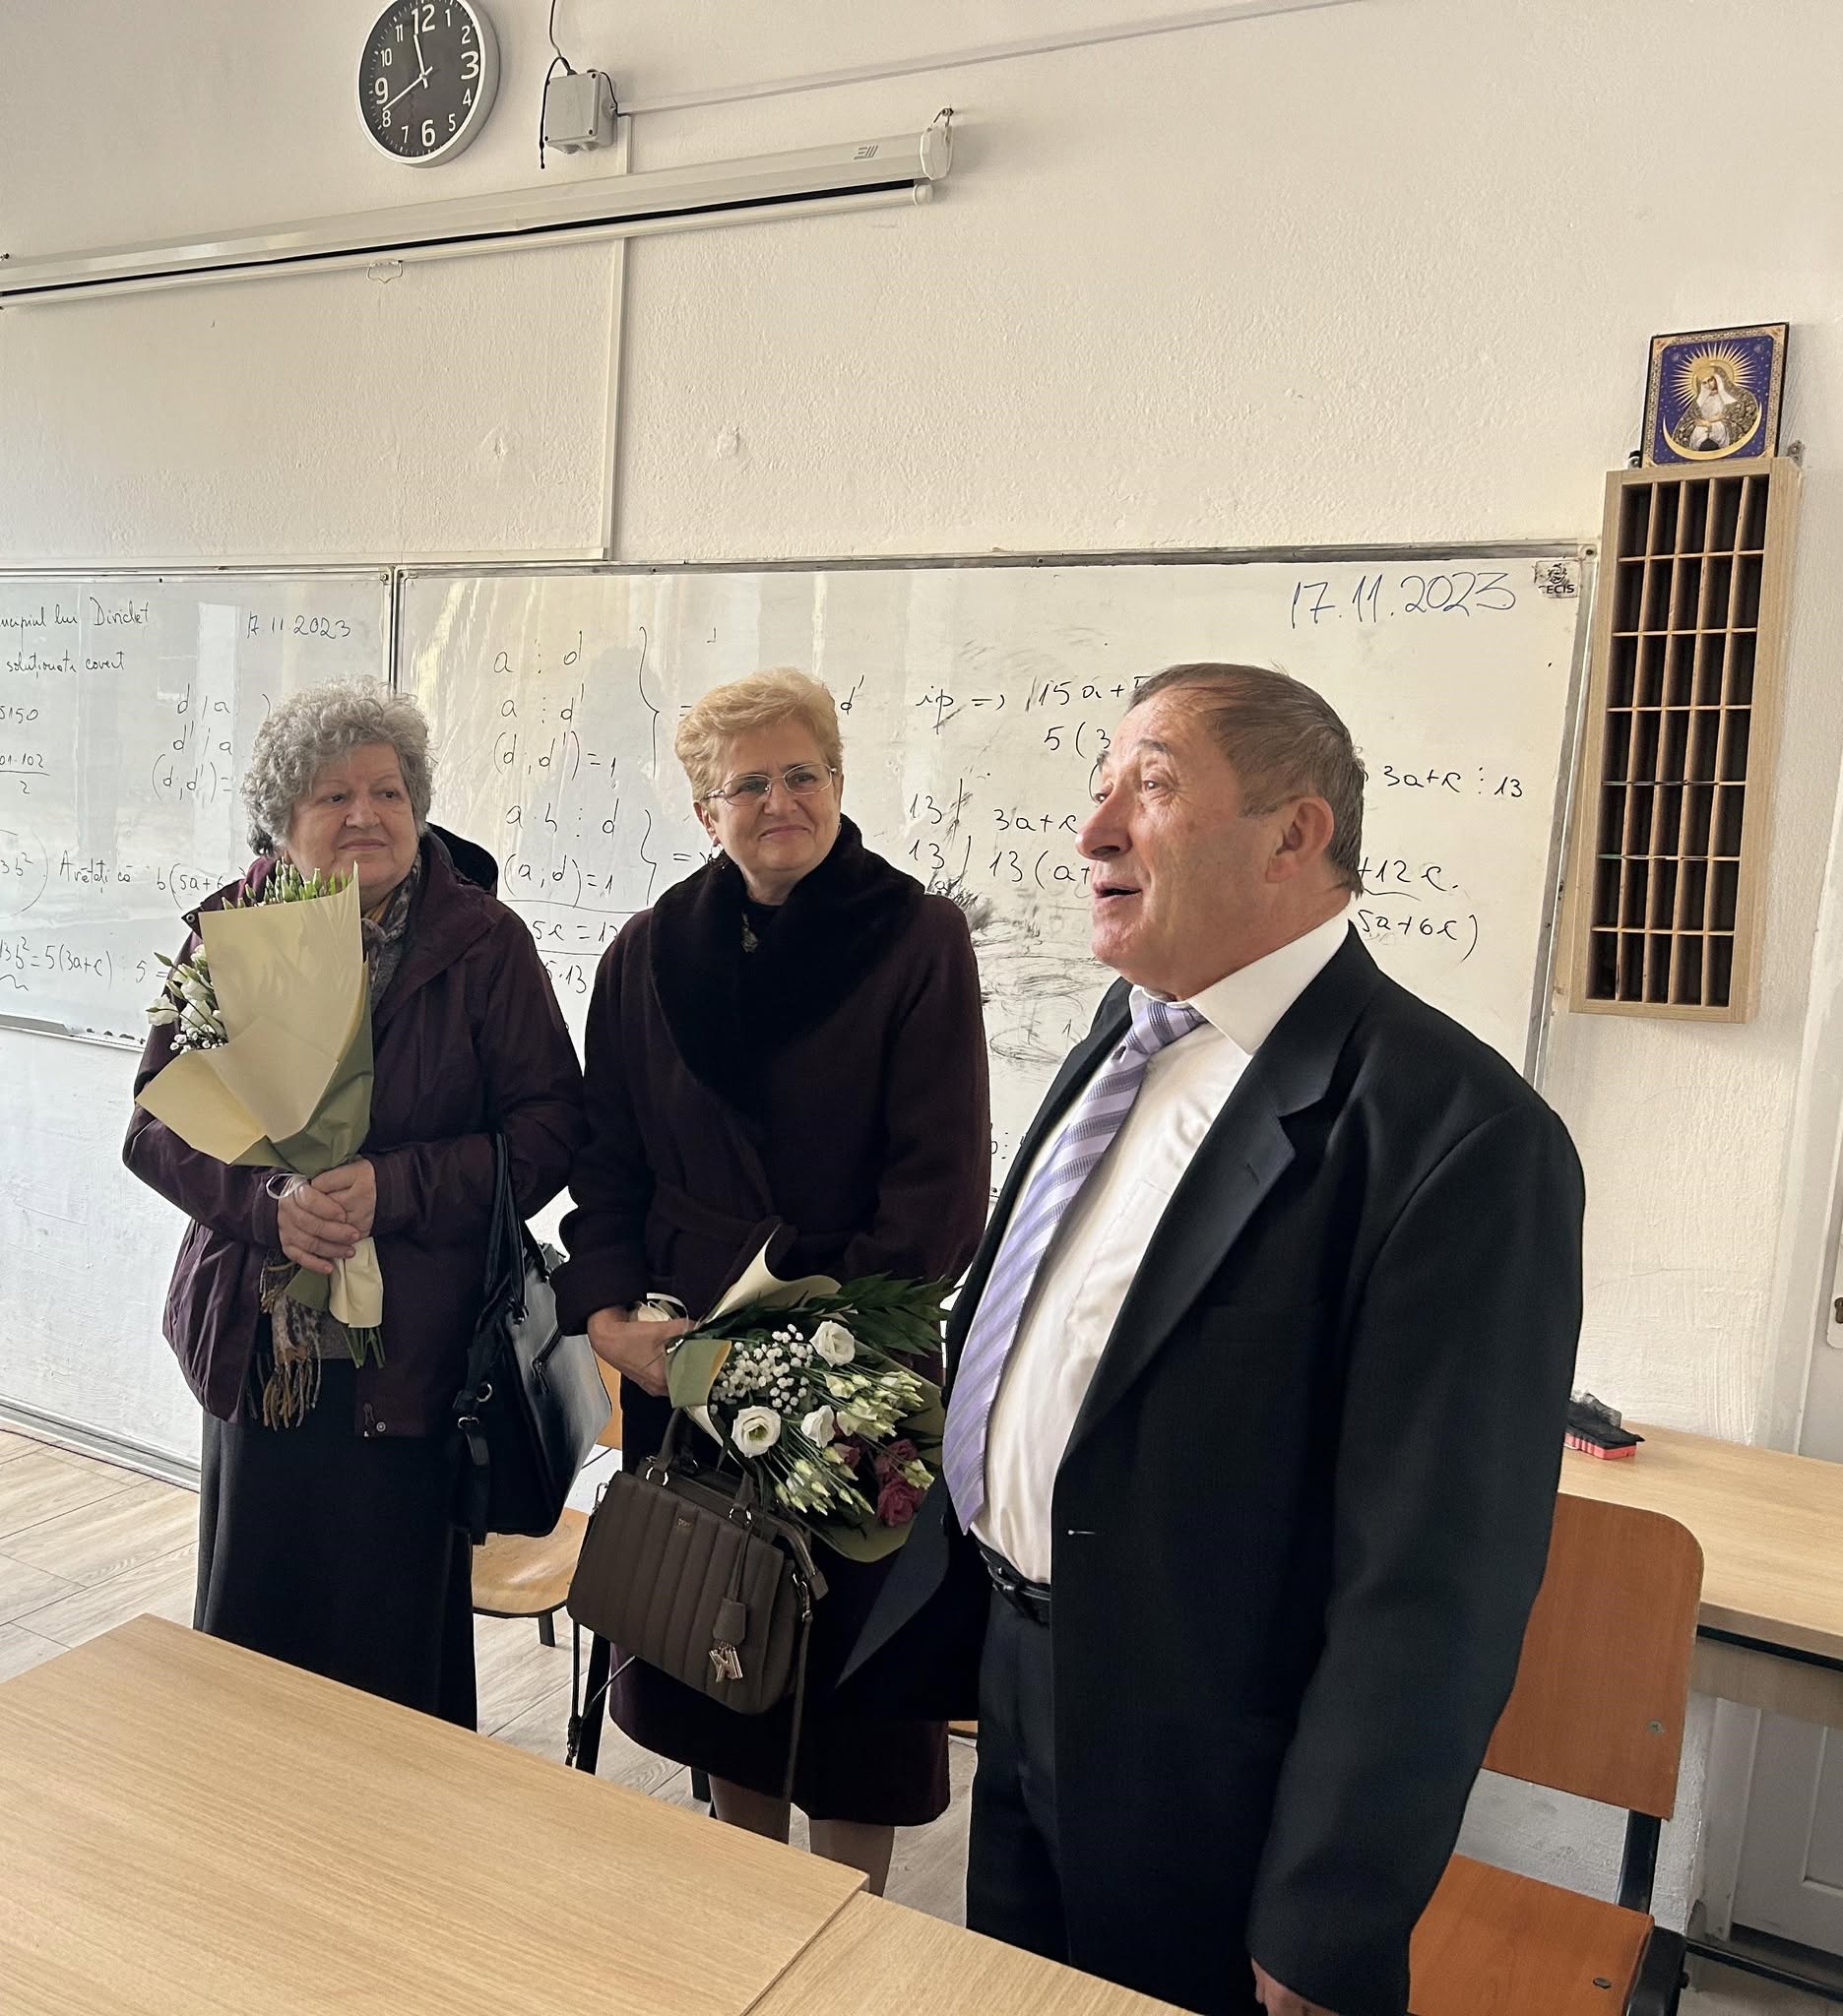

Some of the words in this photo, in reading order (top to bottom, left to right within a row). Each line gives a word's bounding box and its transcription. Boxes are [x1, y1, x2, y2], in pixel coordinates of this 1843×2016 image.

[412, 4, 436, 34] 12
[445, 9, 451, 27] 1
[395, 24, 404, 42] 11
[461, 26, 471, 44] 2
[380, 48, 392, 67] 10
[461, 51, 479, 80] 3
[374, 77, 389, 104] 9
[462, 89, 472, 106] 4
[382, 110, 391, 127] 8
[448, 113, 456, 132] 5
[402, 125, 409, 143] 7
[421, 119, 436, 147] 6
